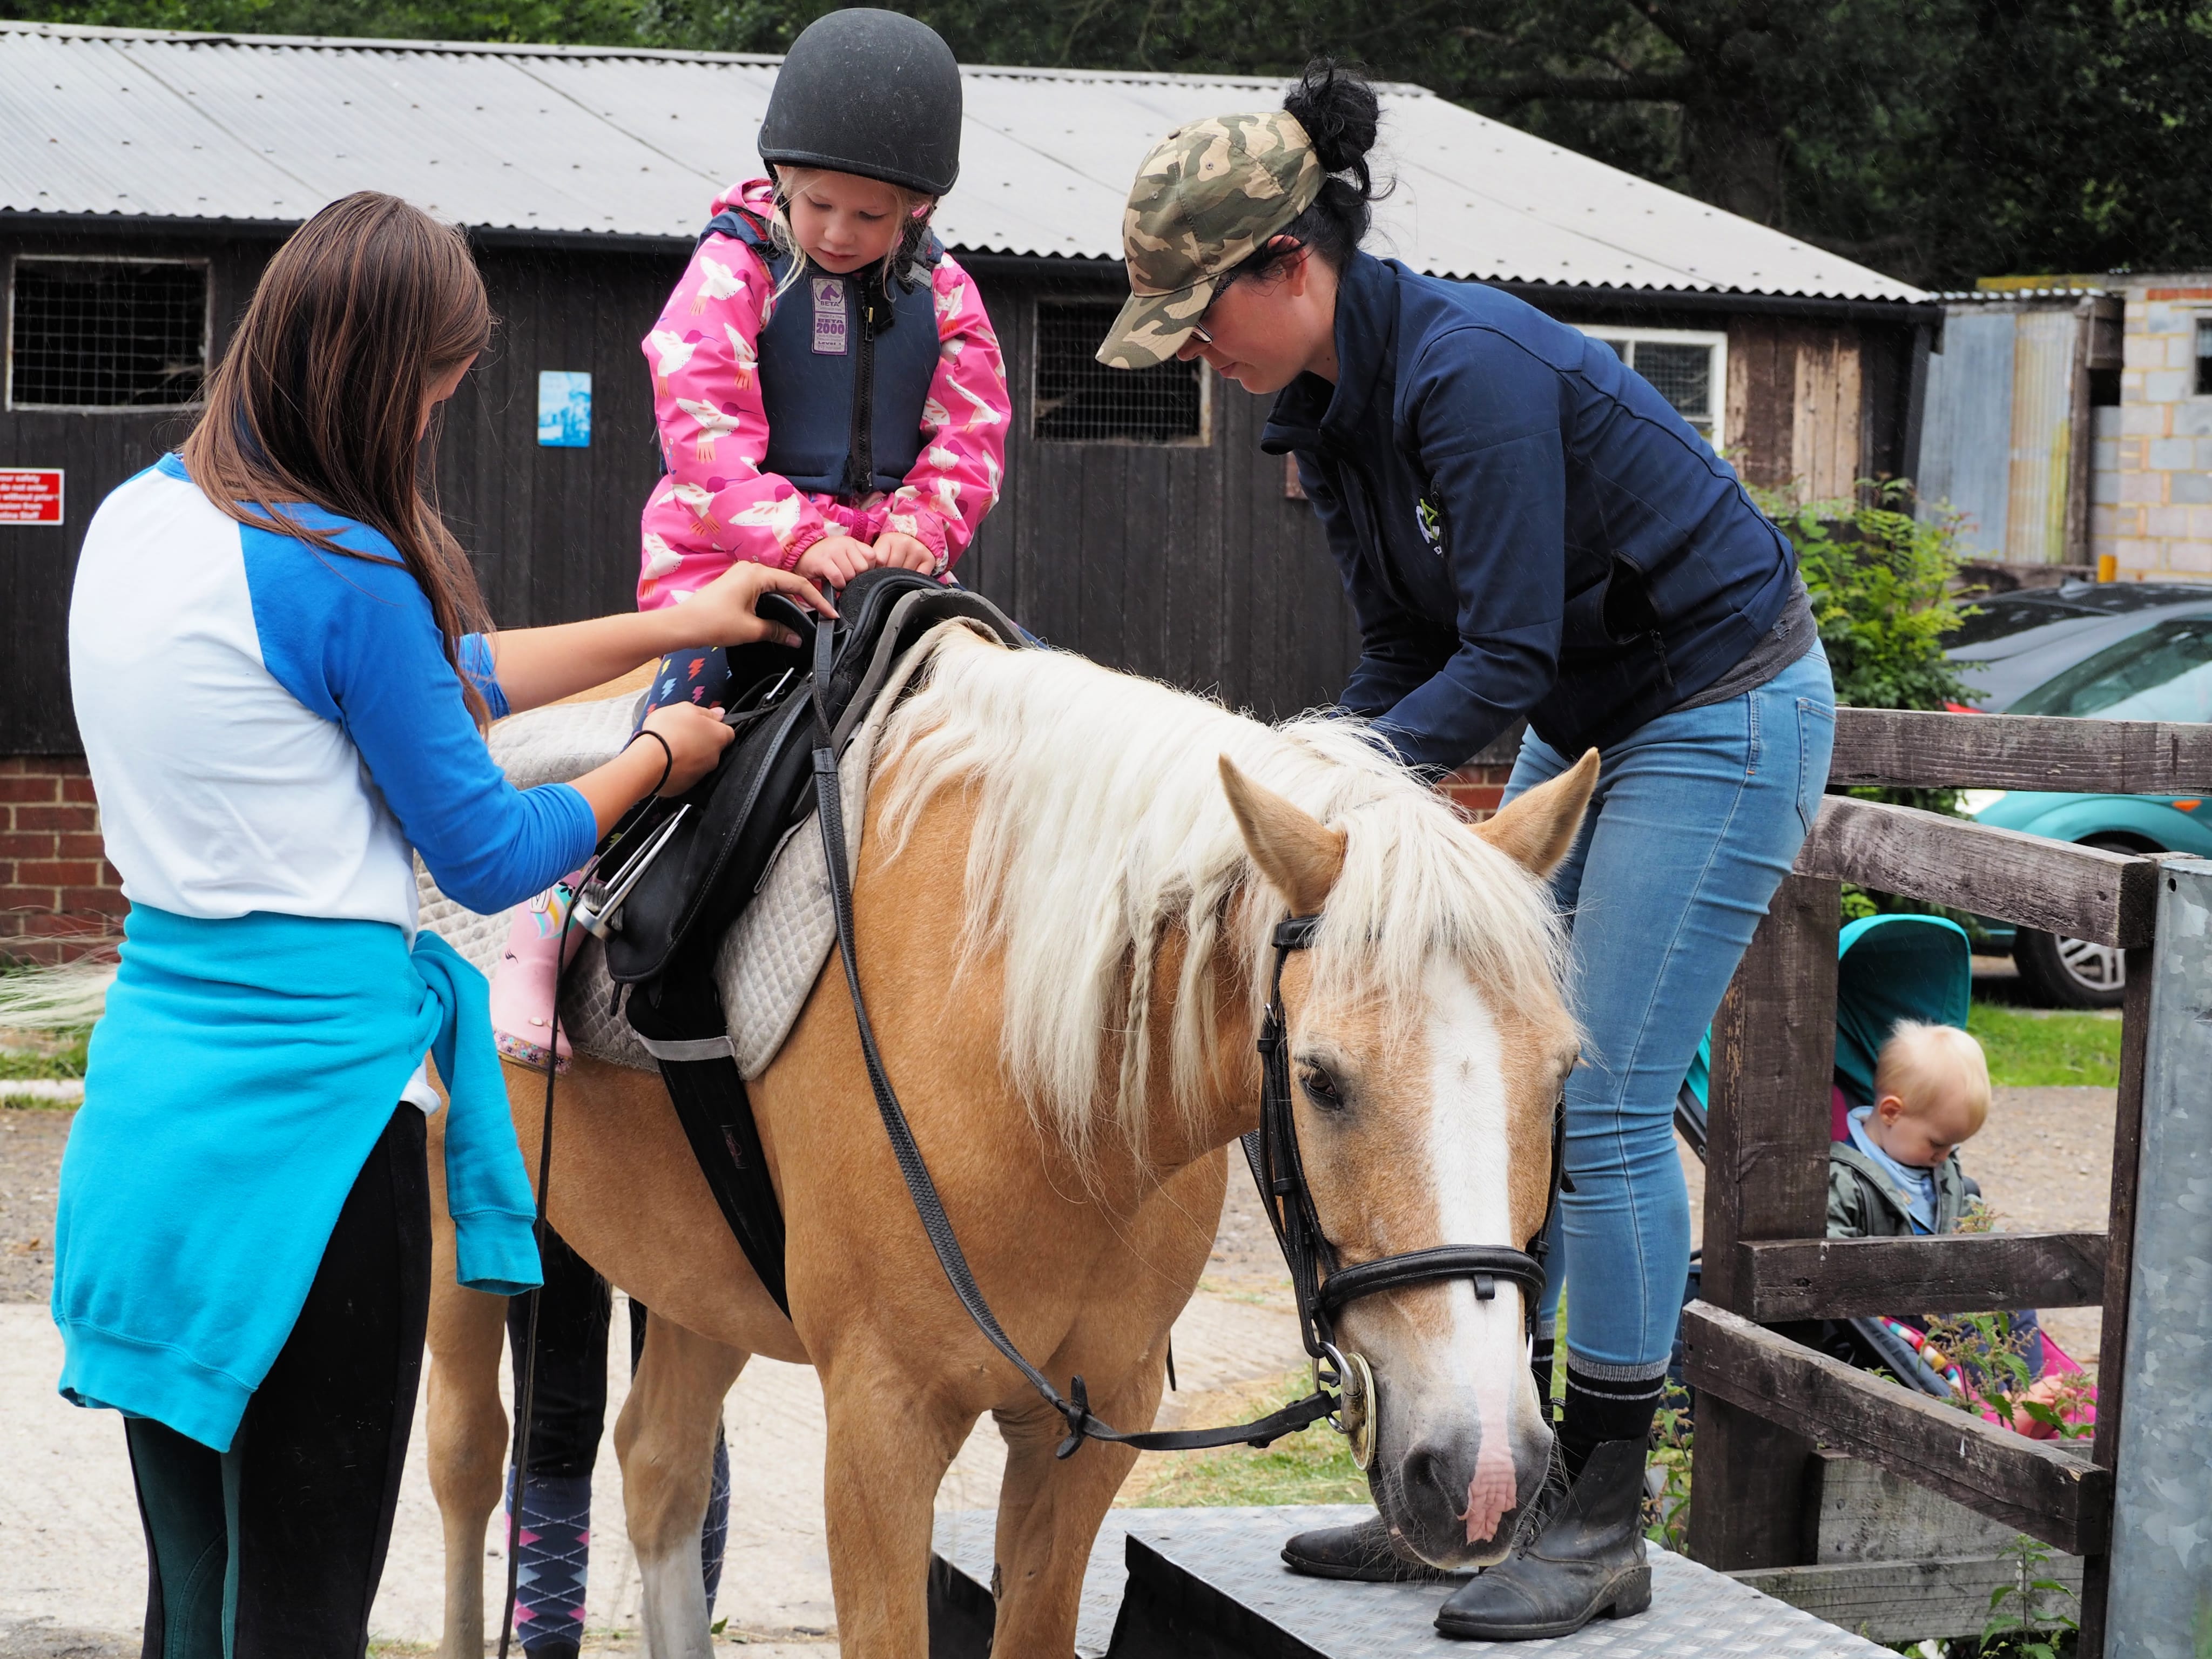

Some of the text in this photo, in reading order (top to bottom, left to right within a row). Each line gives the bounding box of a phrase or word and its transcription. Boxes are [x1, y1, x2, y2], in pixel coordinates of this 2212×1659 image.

[817, 323, 845, 334] 2000
[15, 474, 41, 484] safety
[11, 483, 26, 491] not
[26, 484, 49, 492] enter
[2, 493, 33, 502] without
[33, 493, 54, 503] prior
[22, 502, 43, 511] from
[19, 510, 40, 520] Staff
